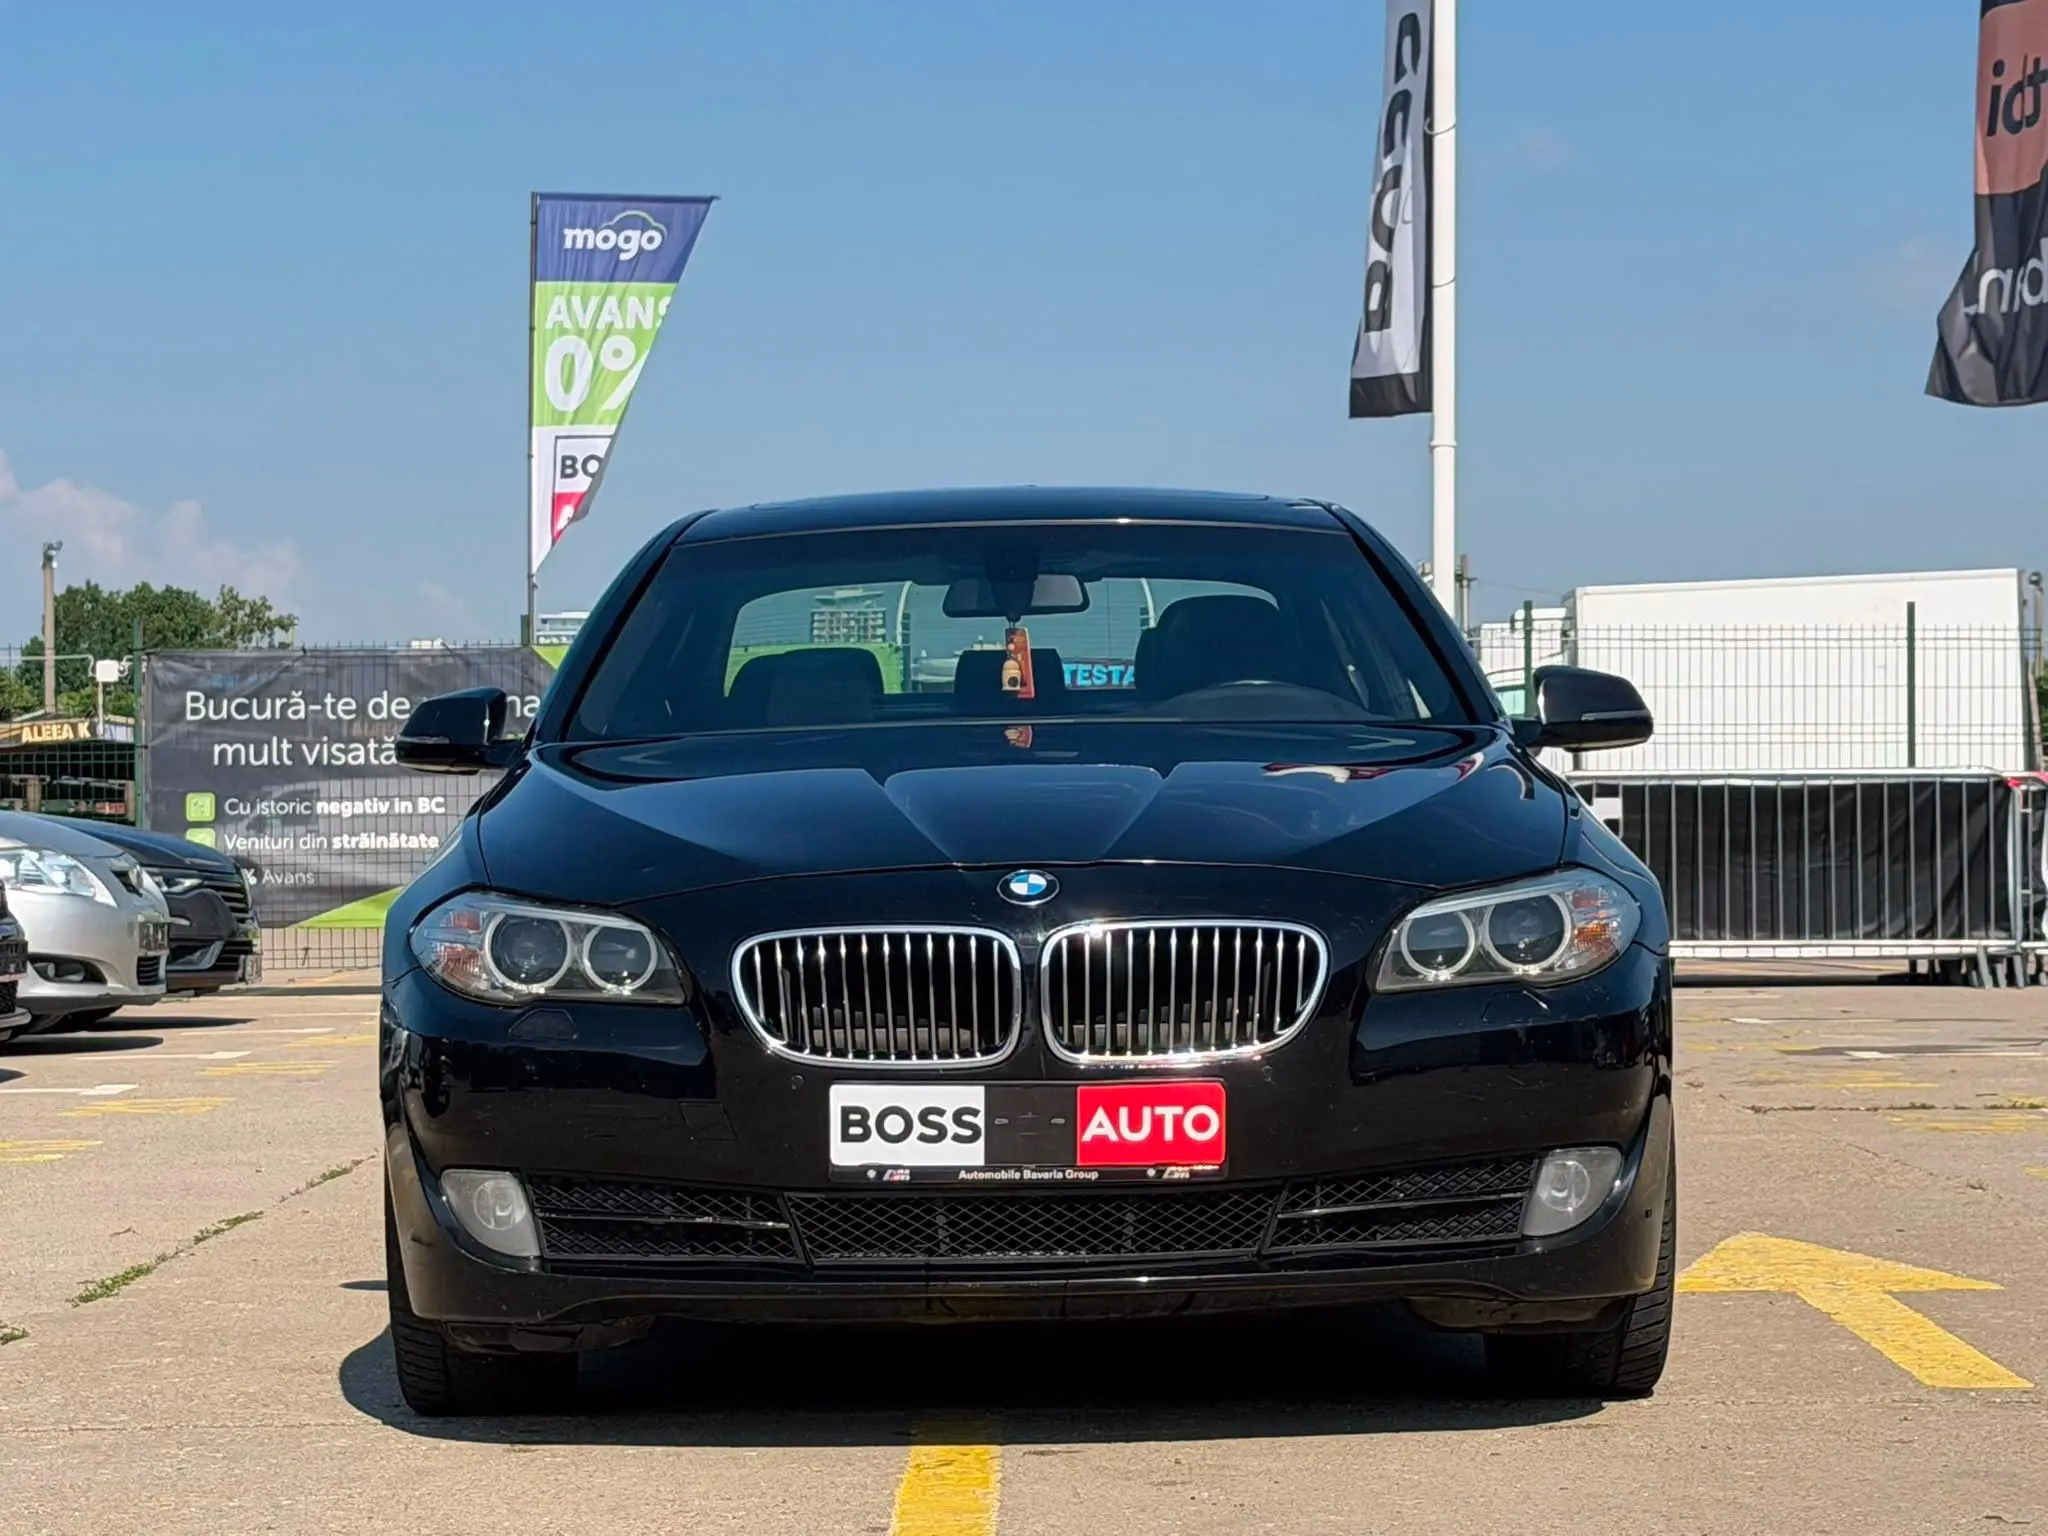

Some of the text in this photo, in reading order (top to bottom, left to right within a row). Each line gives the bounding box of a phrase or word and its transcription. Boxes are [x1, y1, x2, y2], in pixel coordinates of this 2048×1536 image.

[563, 227, 662, 261] mogo
[185, 689, 358, 721] Bucură-te
[367, 689, 412, 720] de
[21, 723, 75, 743] ALEEA
[212, 735, 399, 767] mult visată
[223, 797, 252, 815] Cu
[256, 797, 312, 815] istoric
[316, 797, 391, 818] negativ
[417, 796, 446, 814] BC
[223, 833, 295, 850] Venituri
[299, 832, 328, 850] din
[261, 867, 317, 886] Avans
[839, 1104, 1221, 1145] BOSS AUTO
[957, 1168, 1100, 1181] Automobile Bavaria Group
